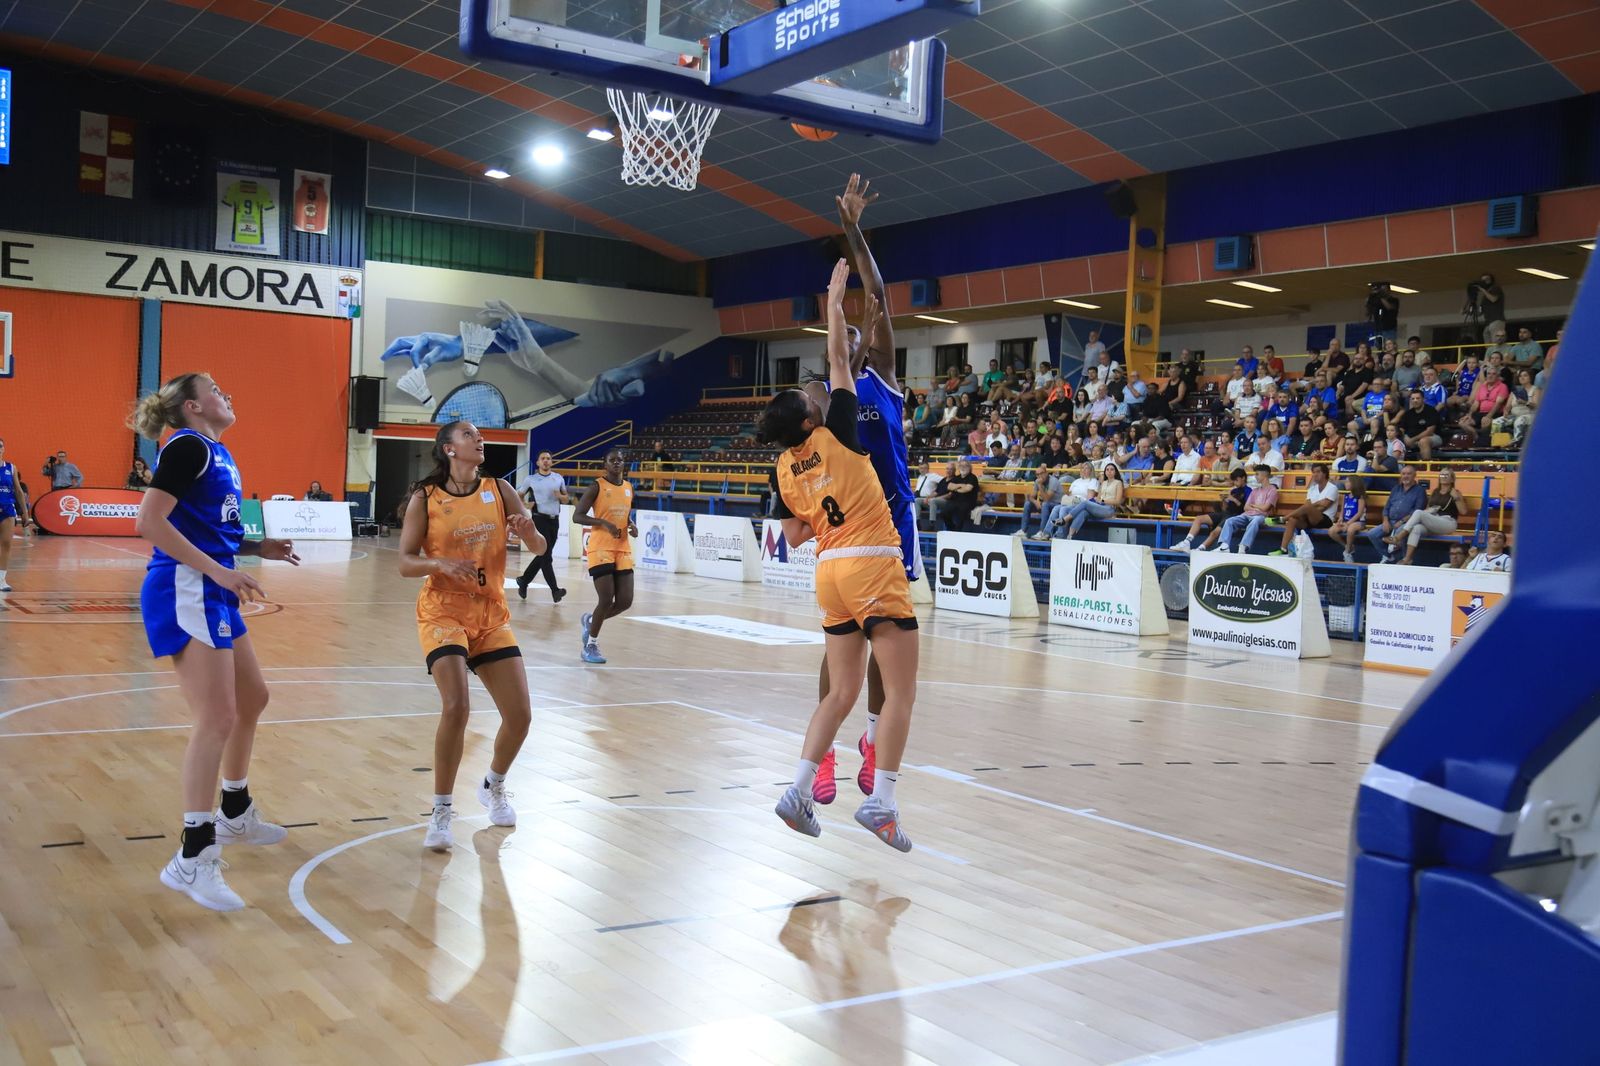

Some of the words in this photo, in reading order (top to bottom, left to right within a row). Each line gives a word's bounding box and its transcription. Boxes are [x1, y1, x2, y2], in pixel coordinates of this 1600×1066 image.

[775, 12, 840, 51] Sports
[244, 200, 252, 215] 9
[105, 251, 324, 309] ZAMORA
[821, 495, 845, 527] 8
[244, 523, 262, 535] AL
[280, 525, 315, 533] recoletas
[984, 591, 1007, 601] CRUCES
[1202, 574, 1246, 599] Paulino
[1251, 578, 1293, 606] Iglesias
[1381, 583, 1403, 592] CAMINO
[1419, 586, 1435, 595] PLATA
[1116, 603, 1133, 616] S.L.
[1217, 604, 1243, 613] Embutidos
[1247, 608, 1271, 616] Jamones
[1053, 608, 1133, 627] SEÑALIZACIONES
[1192, 627, 1297, 651] www.paulinoiglesias.com
[1370, 628, 1393, 638] SERVICIO
[1398, 632, 1427, 642] DOMICILIO
[1427, 635, 1434, 643] DE
